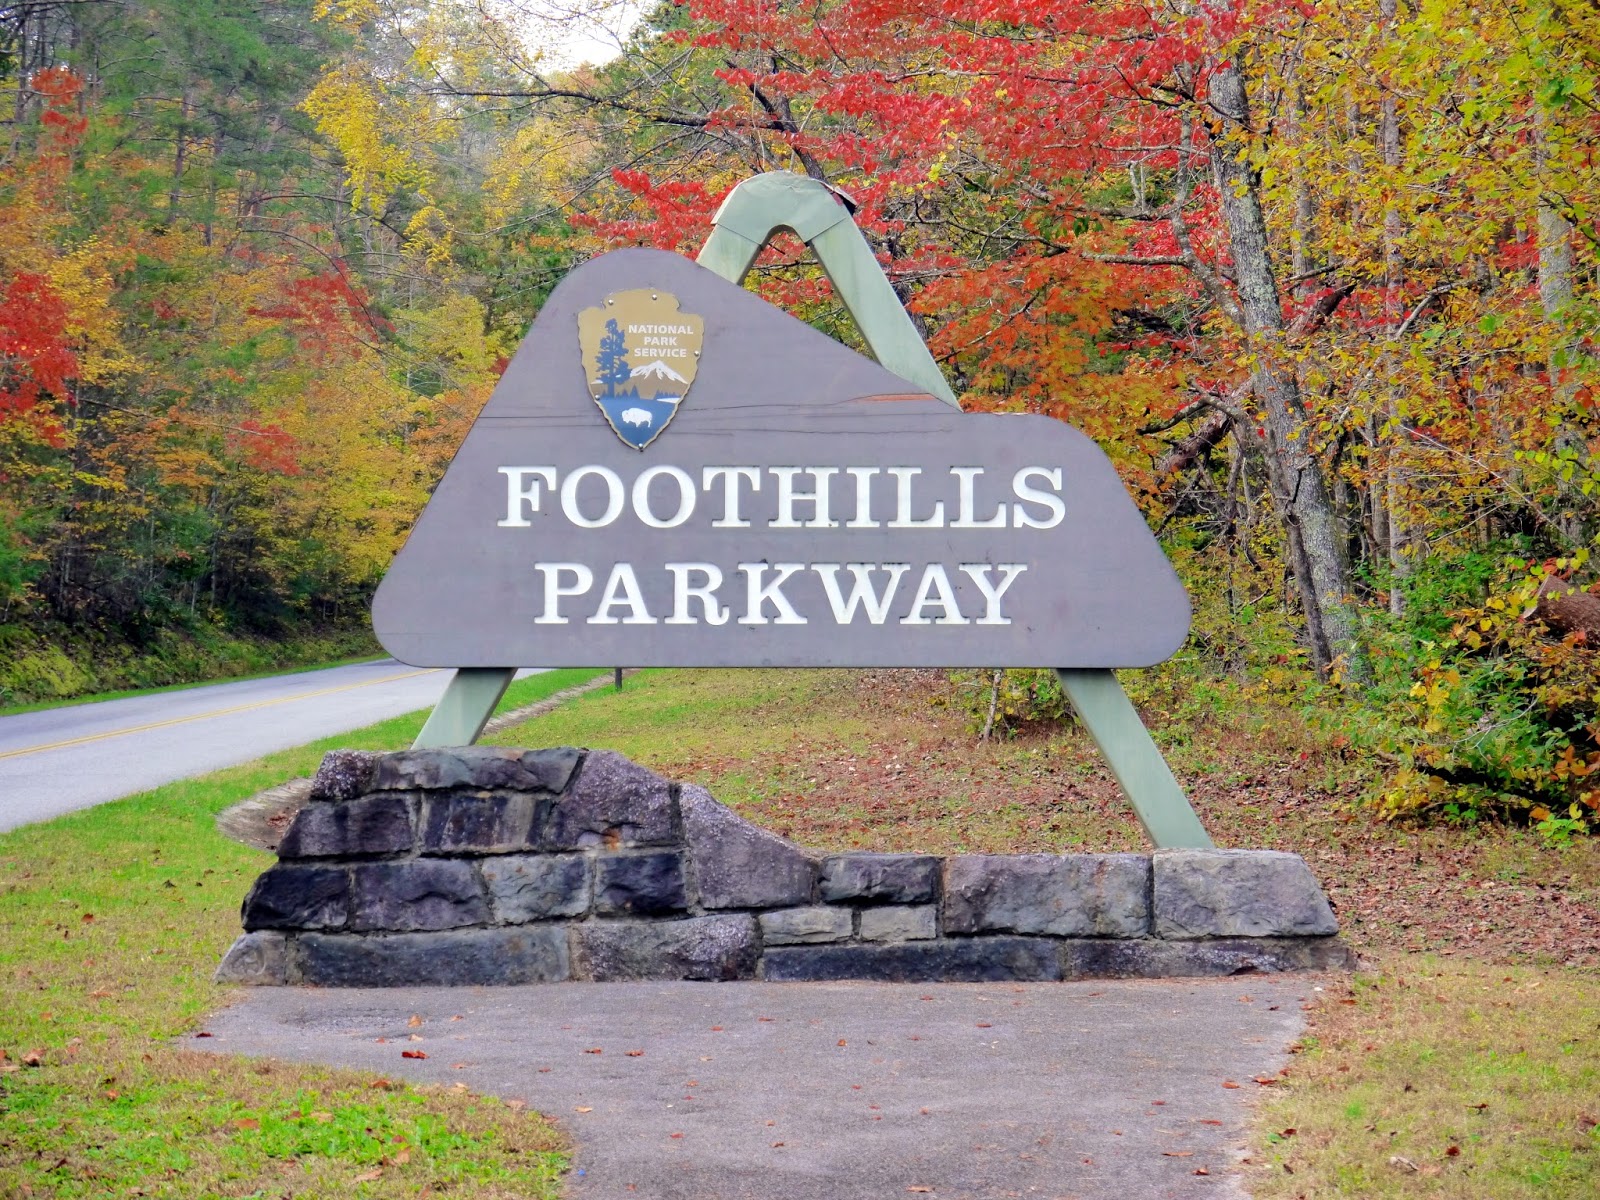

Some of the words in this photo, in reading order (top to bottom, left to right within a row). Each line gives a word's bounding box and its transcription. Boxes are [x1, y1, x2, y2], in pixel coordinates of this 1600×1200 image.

[628, 324, 694, 335] NATIONAL
[643, 336, 678, 346] PARK
[634, 348, 687, 358] SERVICE
[498, 466, 1065, 529] FOOTHILLS
[535, 564, 1027, 625] PARKWAY
